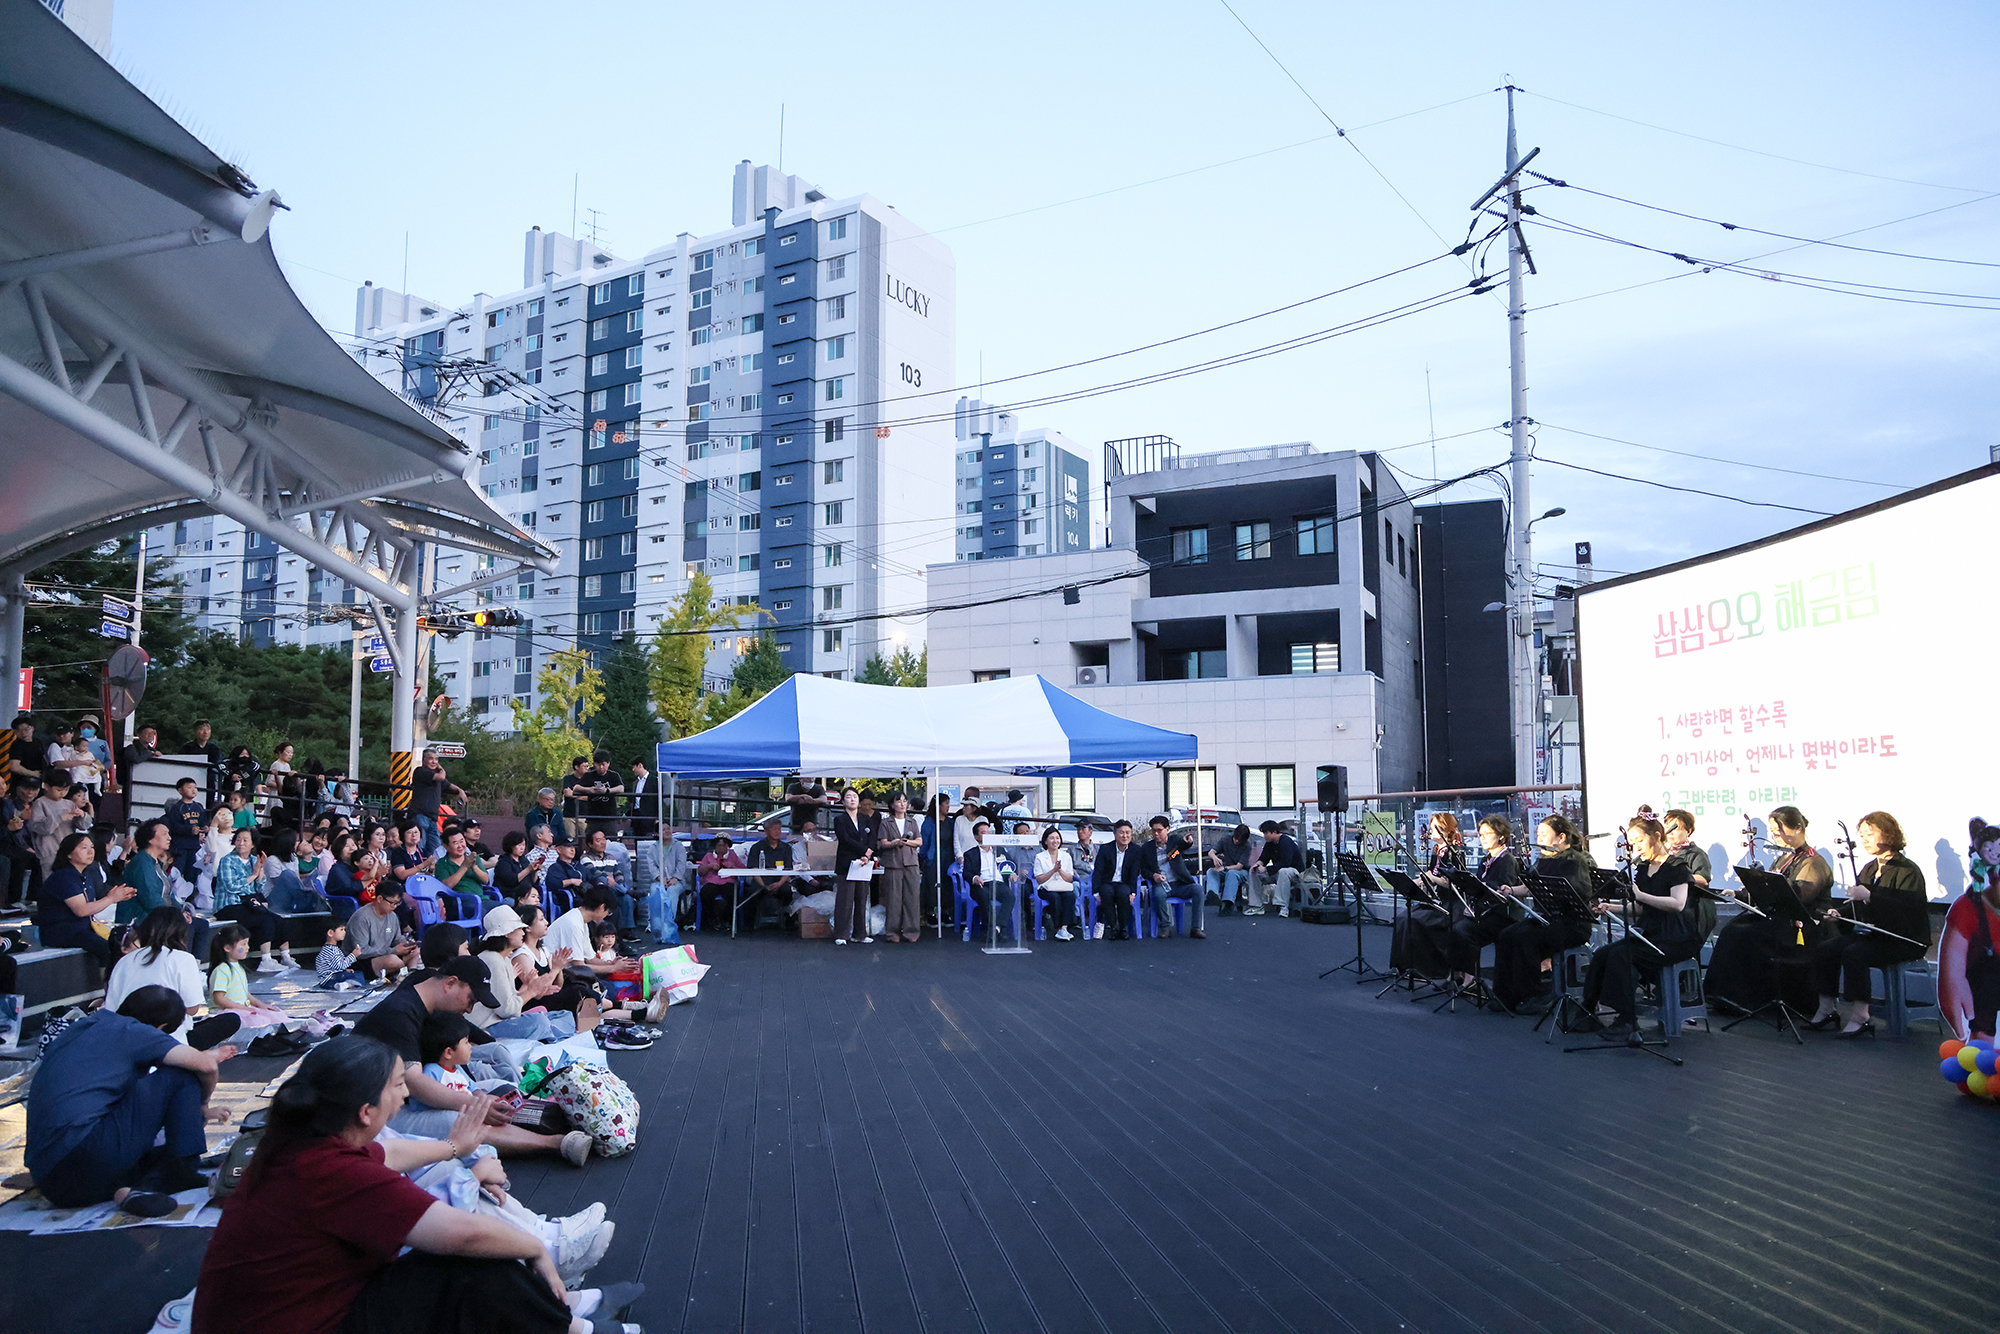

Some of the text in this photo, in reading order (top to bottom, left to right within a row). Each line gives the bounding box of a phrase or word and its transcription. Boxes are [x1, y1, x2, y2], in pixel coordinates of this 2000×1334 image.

[886, 273, 931, 318] LUCKY
[900, 362, 921, 387] 103
[1065, 504, 1079, 523] 럭키
[1067, 531, 1079, 547] 104
[1775, 562, 1880, 632] 해금팀
[1658, 701, 1788, 740] 1. 사랑하면 할수록
[1745, 743, 1795, 774] 언제나
[1802, 735, 1898, 771] 몇번이라도
